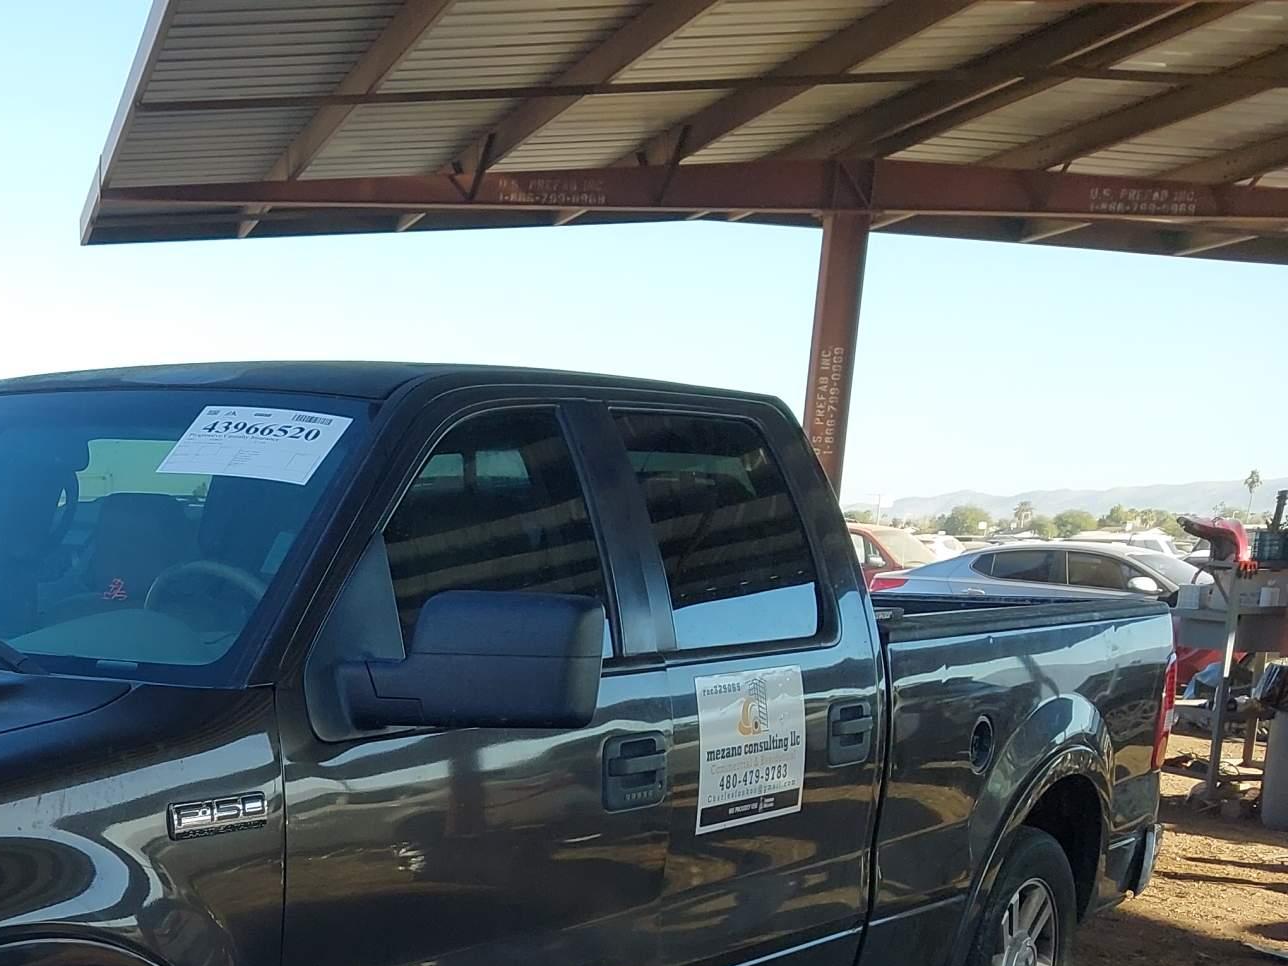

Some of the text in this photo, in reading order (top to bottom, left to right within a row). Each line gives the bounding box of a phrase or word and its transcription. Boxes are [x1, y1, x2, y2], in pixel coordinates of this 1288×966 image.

[814, 375, 829, 425] PREFAB
[202, 420, 321, 442] 43966520
[706, 730, 801, 763] mezano consulting llc
[719, 763, 788, 792] 480-479-9783
